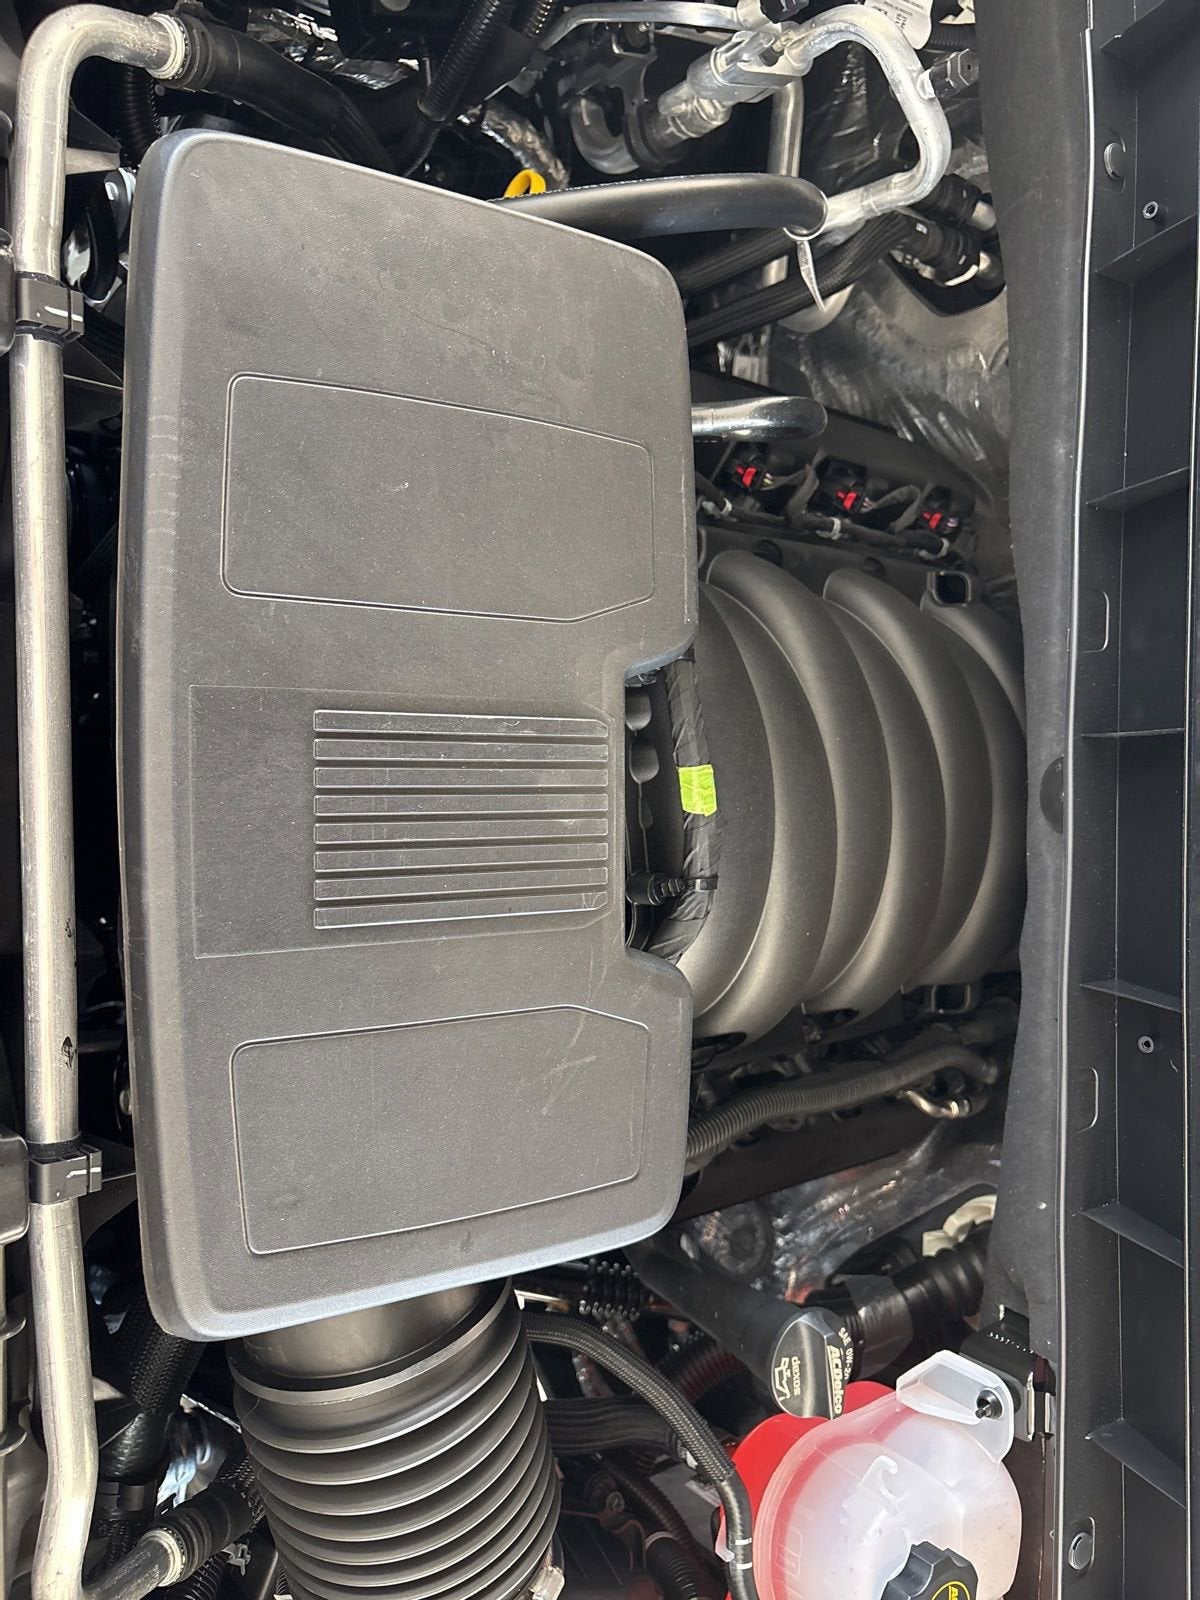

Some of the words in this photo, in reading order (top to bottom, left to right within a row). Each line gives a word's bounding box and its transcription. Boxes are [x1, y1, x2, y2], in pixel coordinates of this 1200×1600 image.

[838, 1327, 852, 1346] SAE
[791, 1356, 801, 1396] dexos
[829, 1345, 844, 1415] ACDelco
